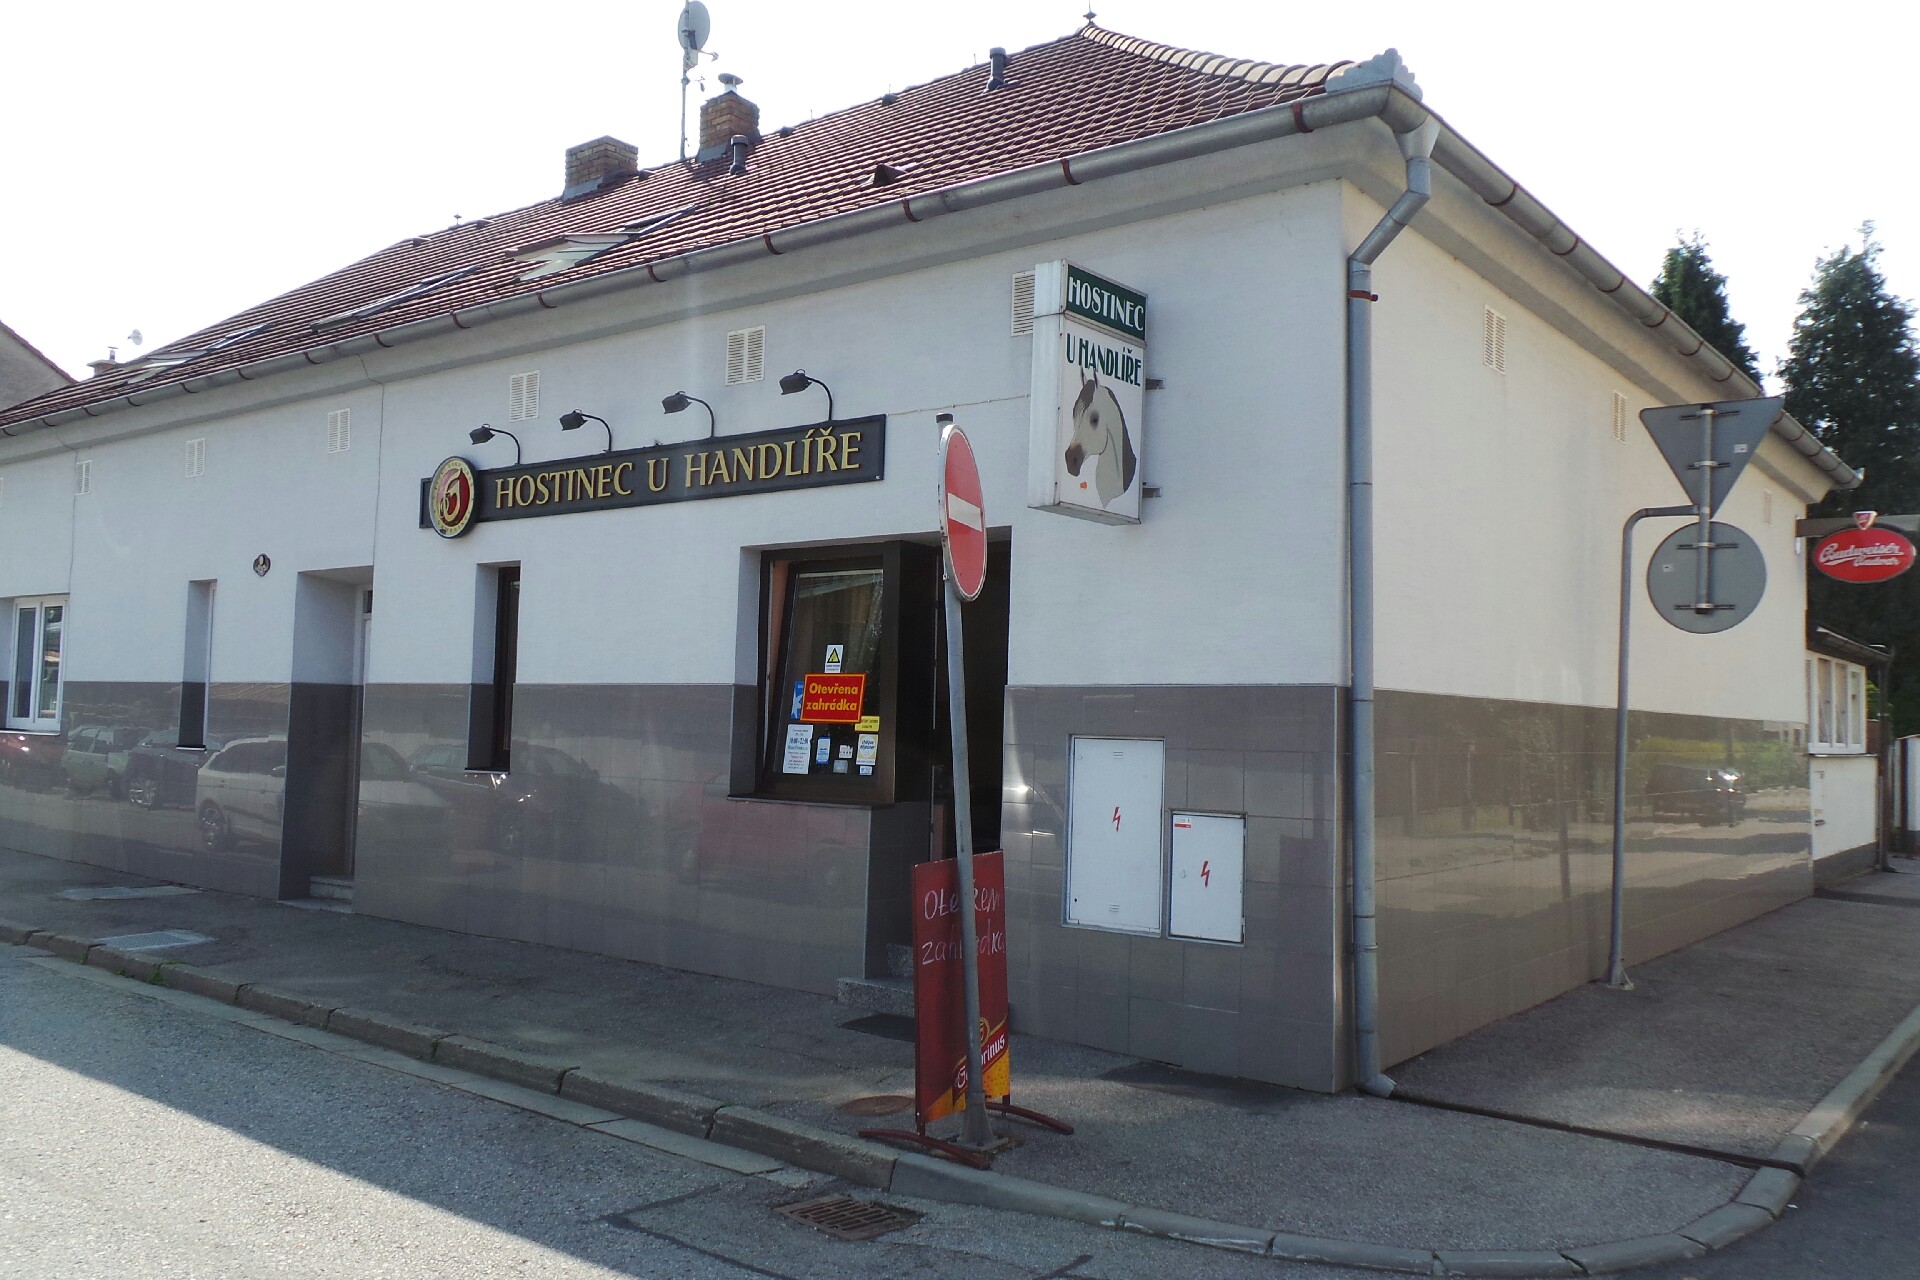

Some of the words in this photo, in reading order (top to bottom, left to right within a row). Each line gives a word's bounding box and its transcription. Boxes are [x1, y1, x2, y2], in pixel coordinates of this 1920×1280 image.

[1068, 276, 1144, 331] HOSTINEC
[1067, 332, 1076, 364] U
[1078, 337, 1142, 387] HANDLÍŘE
[495, 462, 634, 509] HOSTINEC
[648, 457, 670, 493] U
[685, 426, 862, 488] HANDLÍŘE
[806, 698, 858, 711] zahrádka
[809, 683, 858, 695] Otevřena
